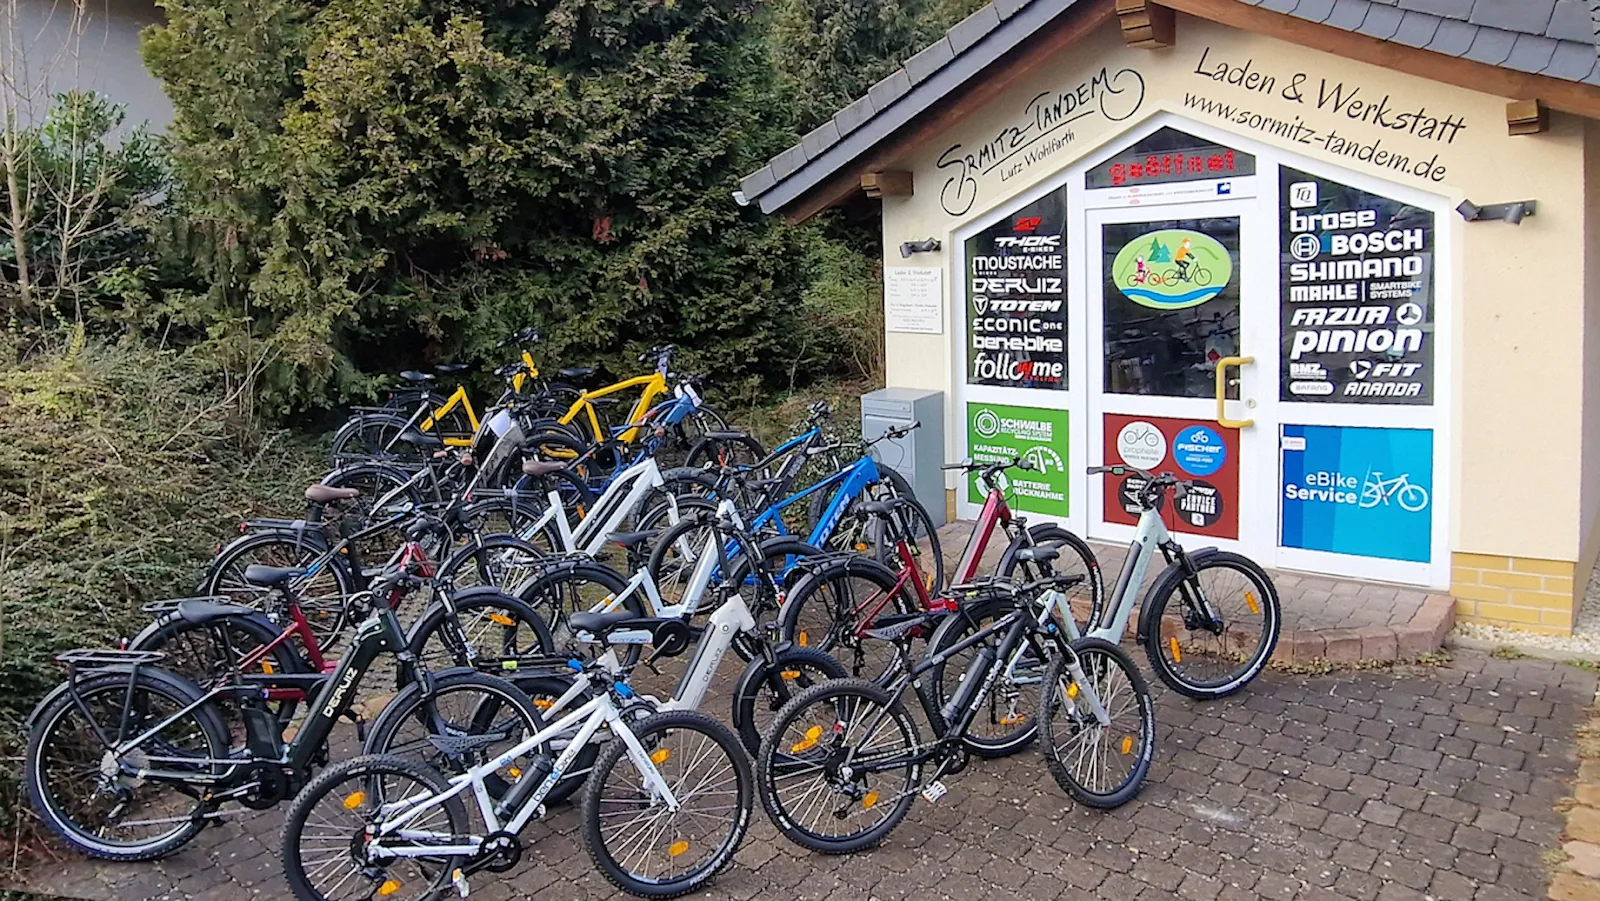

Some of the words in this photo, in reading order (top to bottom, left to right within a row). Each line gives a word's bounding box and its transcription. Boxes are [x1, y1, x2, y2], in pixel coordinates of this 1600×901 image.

[1194, 47, 1276, 94] Laden
[1282, 73, 1307, 104] &
[1317, 78, 1467, 144] Werkstatt
[1184, 92, 1447, 182] www.sormitz-tandem.de
[1000, 164, 1024, 182] Lutz
[1024, 129, 1076, 167] Wohlfarth
[1109, 149, 1235, 185] geöffnet
[1290, 210, 1376, 233] brose
[994, 235, 1061, 248] THOK
[1331, 229, 1424, 256] BOSCH
[972, 255, 1062, 272] MOUSTACHE
[1290, 256, 1423, 282] SHIMANO
[972, 277, 1062, 294] DERUIZ
[1290, 283, 1358, 302] MAHLE
[1369, 280, 1422, 291] SMARTBIKE
[1369, 289, 1413, 300] SYSTEMS
[989, 300, 1062, 313] TOTEM
[1290, 306, 1391, 326] FAZUA
[1290, 328, 1423, 360] pinion
[1372, 362, 1422, 377] FIT
[1295, 383, 1328, 391] BAFANG
[1343, 382, 1422, 397] ANANDA
[1000, 418, 1052, 432] SCHWALBE
[1012, 479, 1051, 491] BATTERIE
[1305, 471, 1358, 488] eBike
[1012, 488, 1064, 501] RÜCKNAHME
[1285, 484, 1358, 504] Service
[322, 667, 358, 718] DERUIZ
